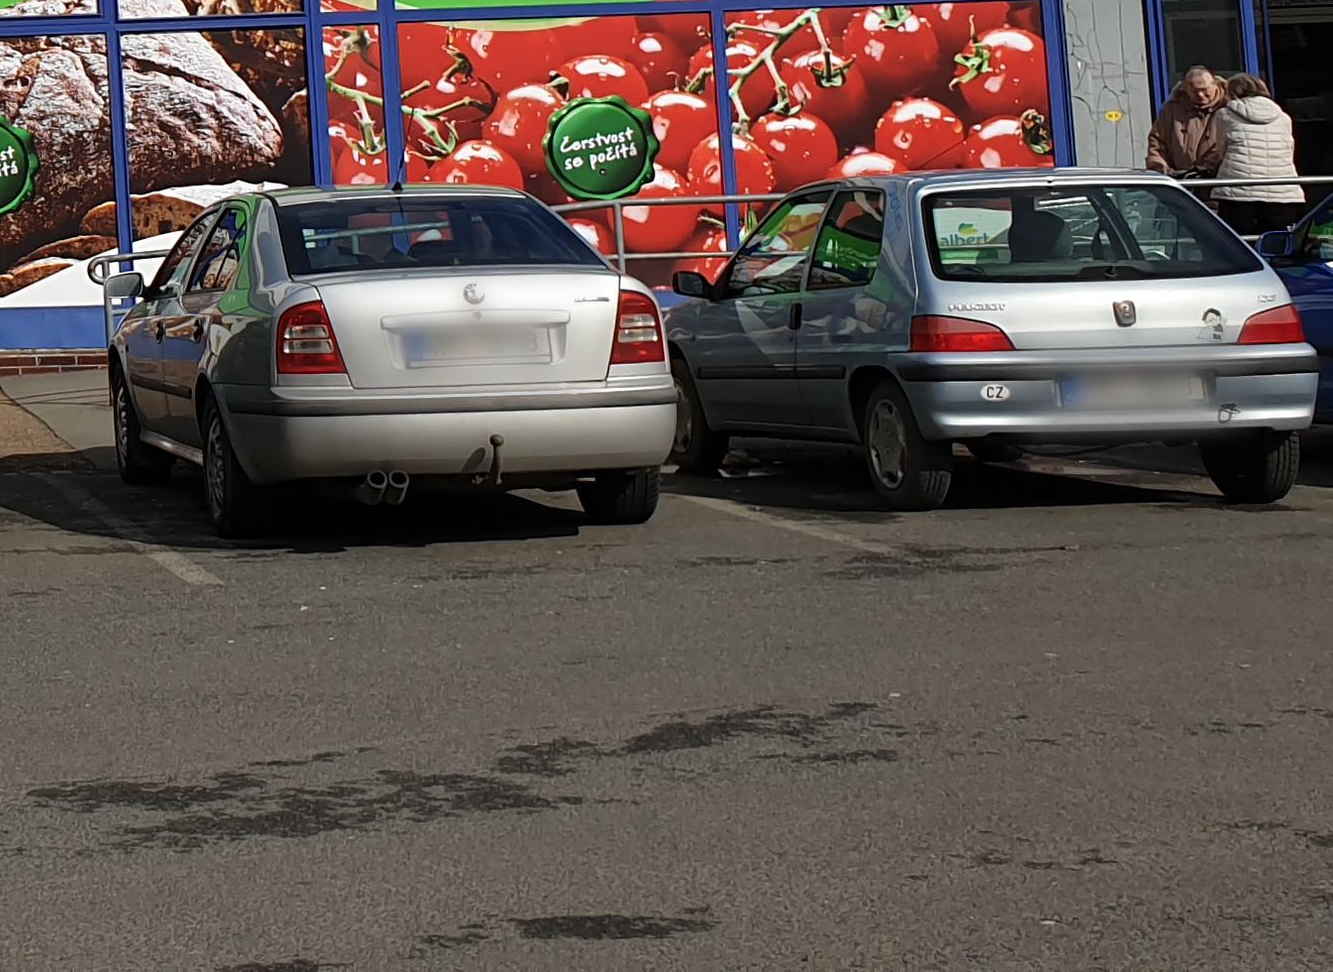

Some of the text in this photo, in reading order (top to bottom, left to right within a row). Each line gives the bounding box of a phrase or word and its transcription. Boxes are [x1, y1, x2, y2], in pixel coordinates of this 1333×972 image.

[560, 126, 634, 153] Čerstvost
[564, 142, 638, 170] se počítá
[940, 232, 989, 245] albert
[986, 386, 1004, 398] CZ
